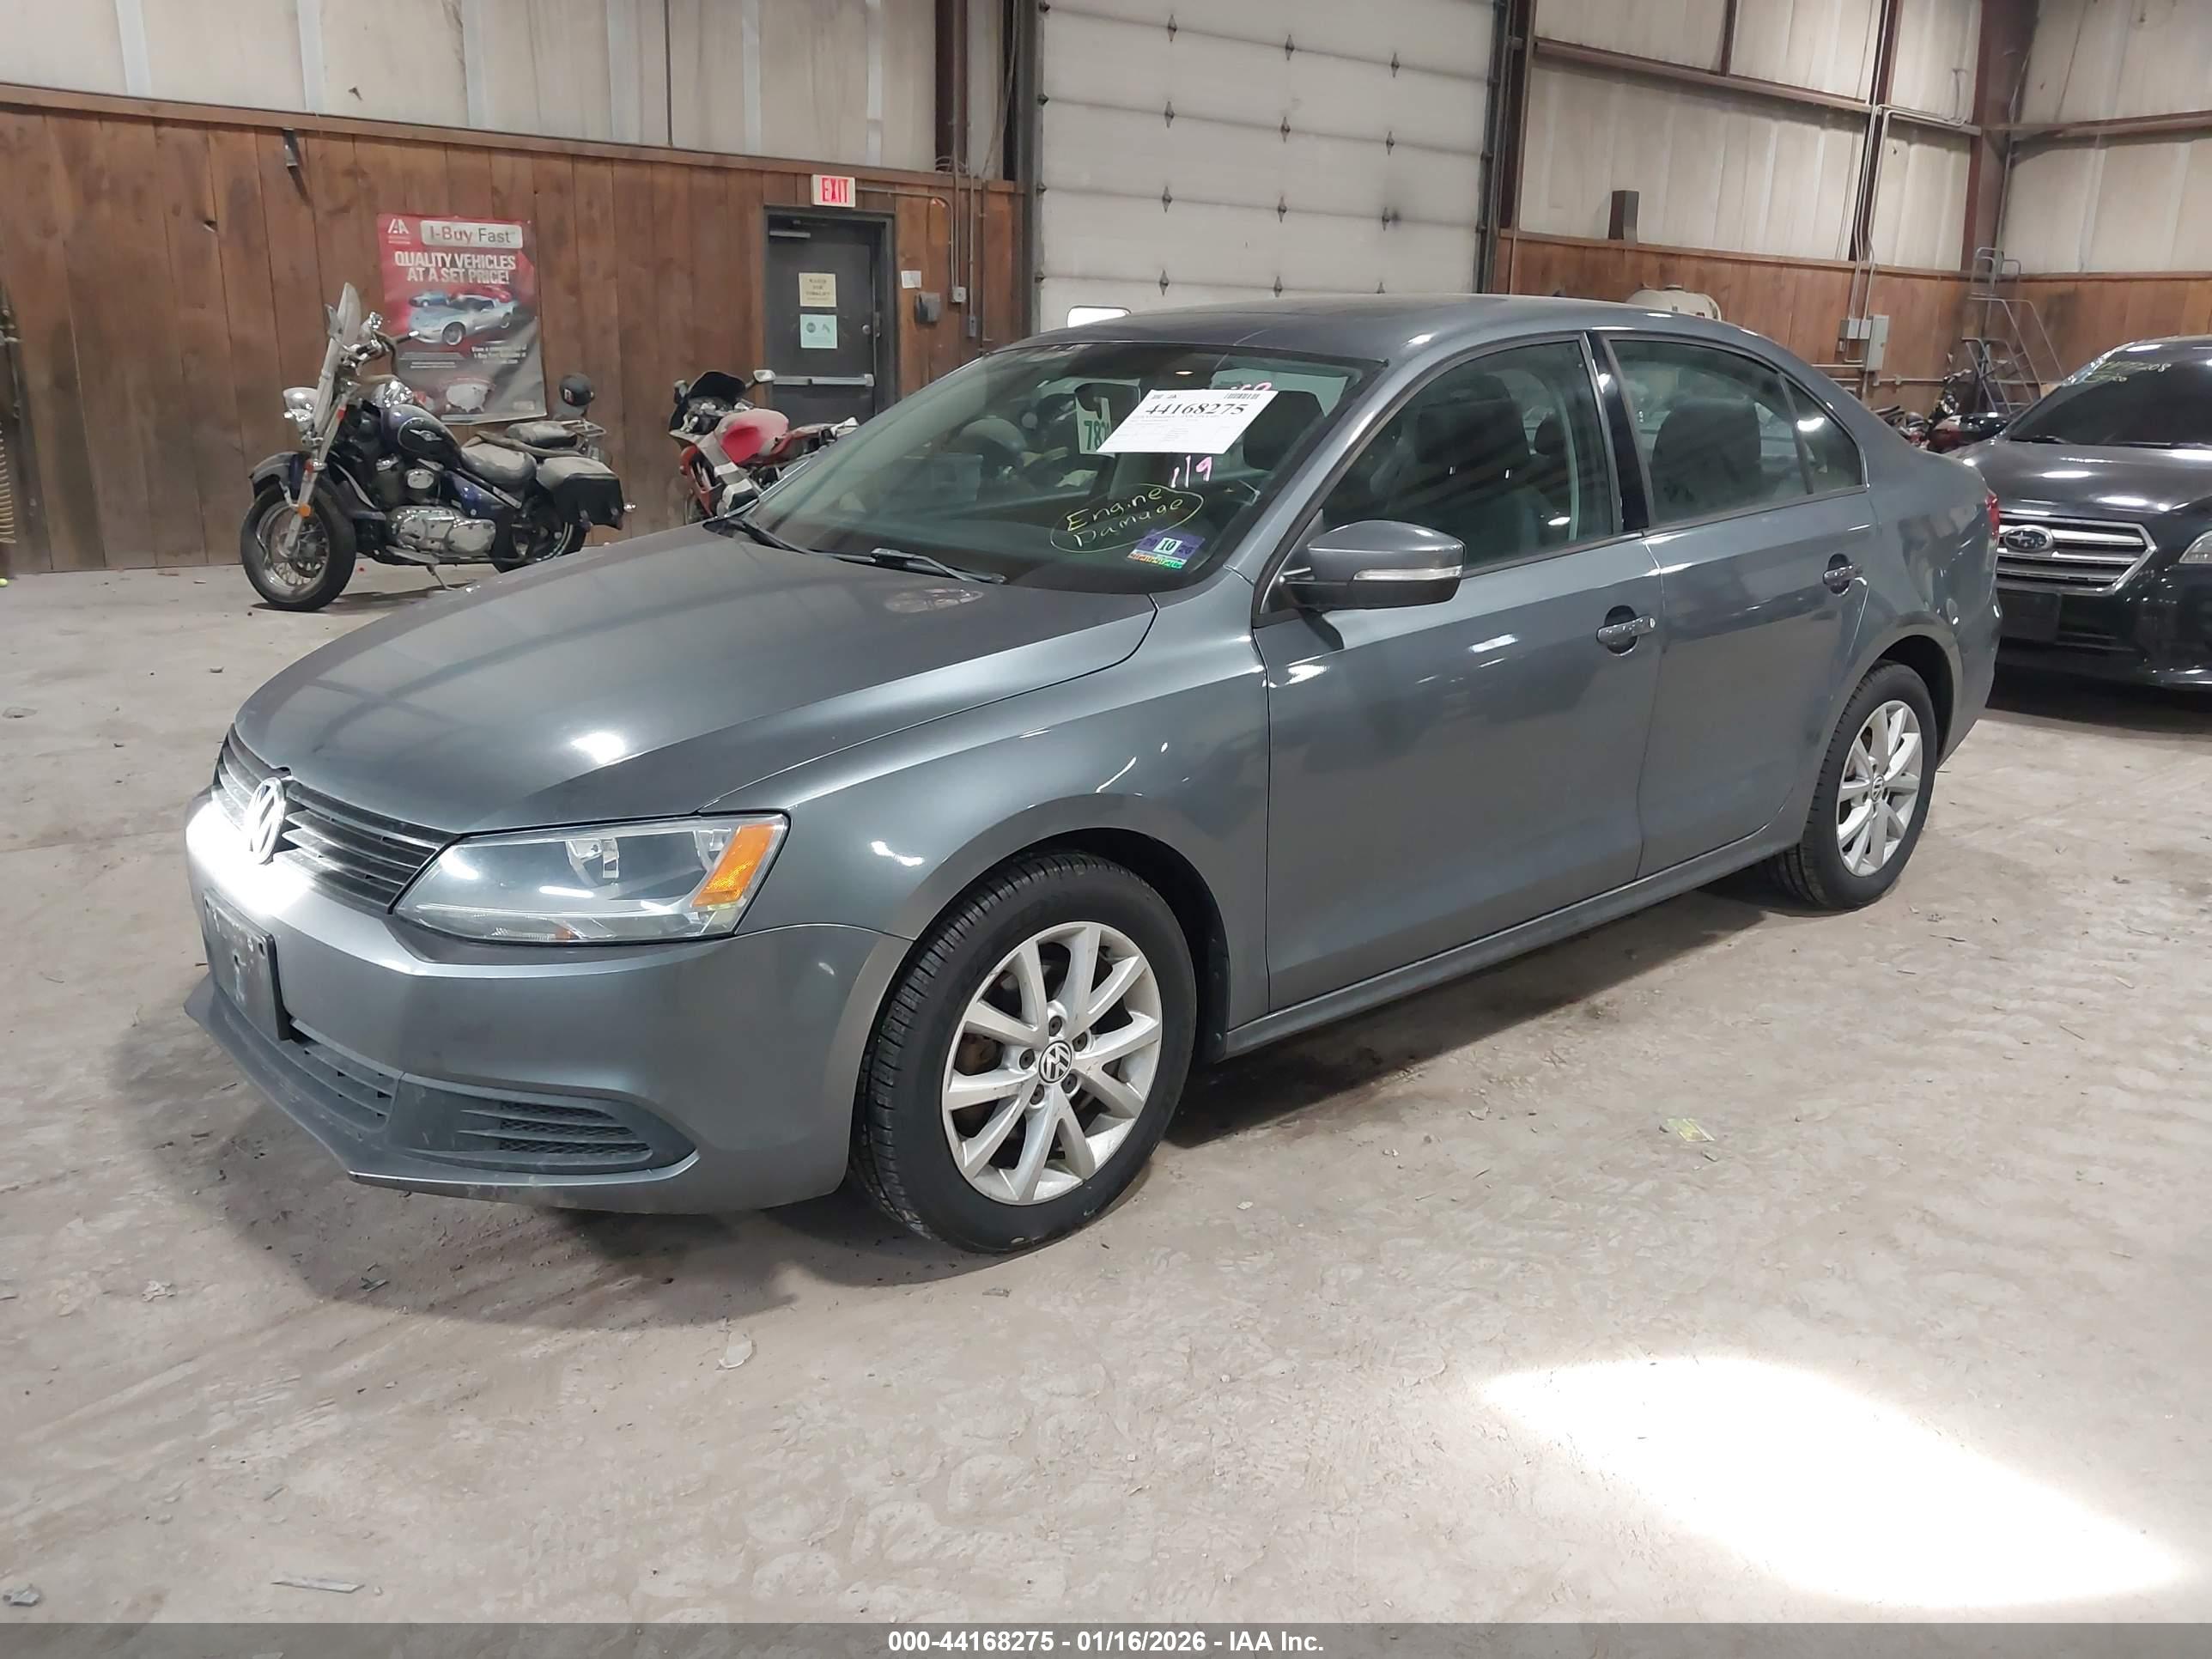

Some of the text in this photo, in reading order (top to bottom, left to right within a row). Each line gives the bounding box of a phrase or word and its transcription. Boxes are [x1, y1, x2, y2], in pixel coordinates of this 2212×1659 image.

[822, 178, 848, 204] EXIT
[430, 226, 472, 244] I-Buy
[478, 228, 512, 244] Fast
[395, 251, 516, 270] QUALITY VEHICLES
[407, 268, 510, 285] AT A SET PRICE!
[1146, 403, 1249, 416] 44168275
[1066, 487, 1163, 532] Engine
[1073, 498, 1184, 547] Damage
[1158, 539, 1177, 551] 10
